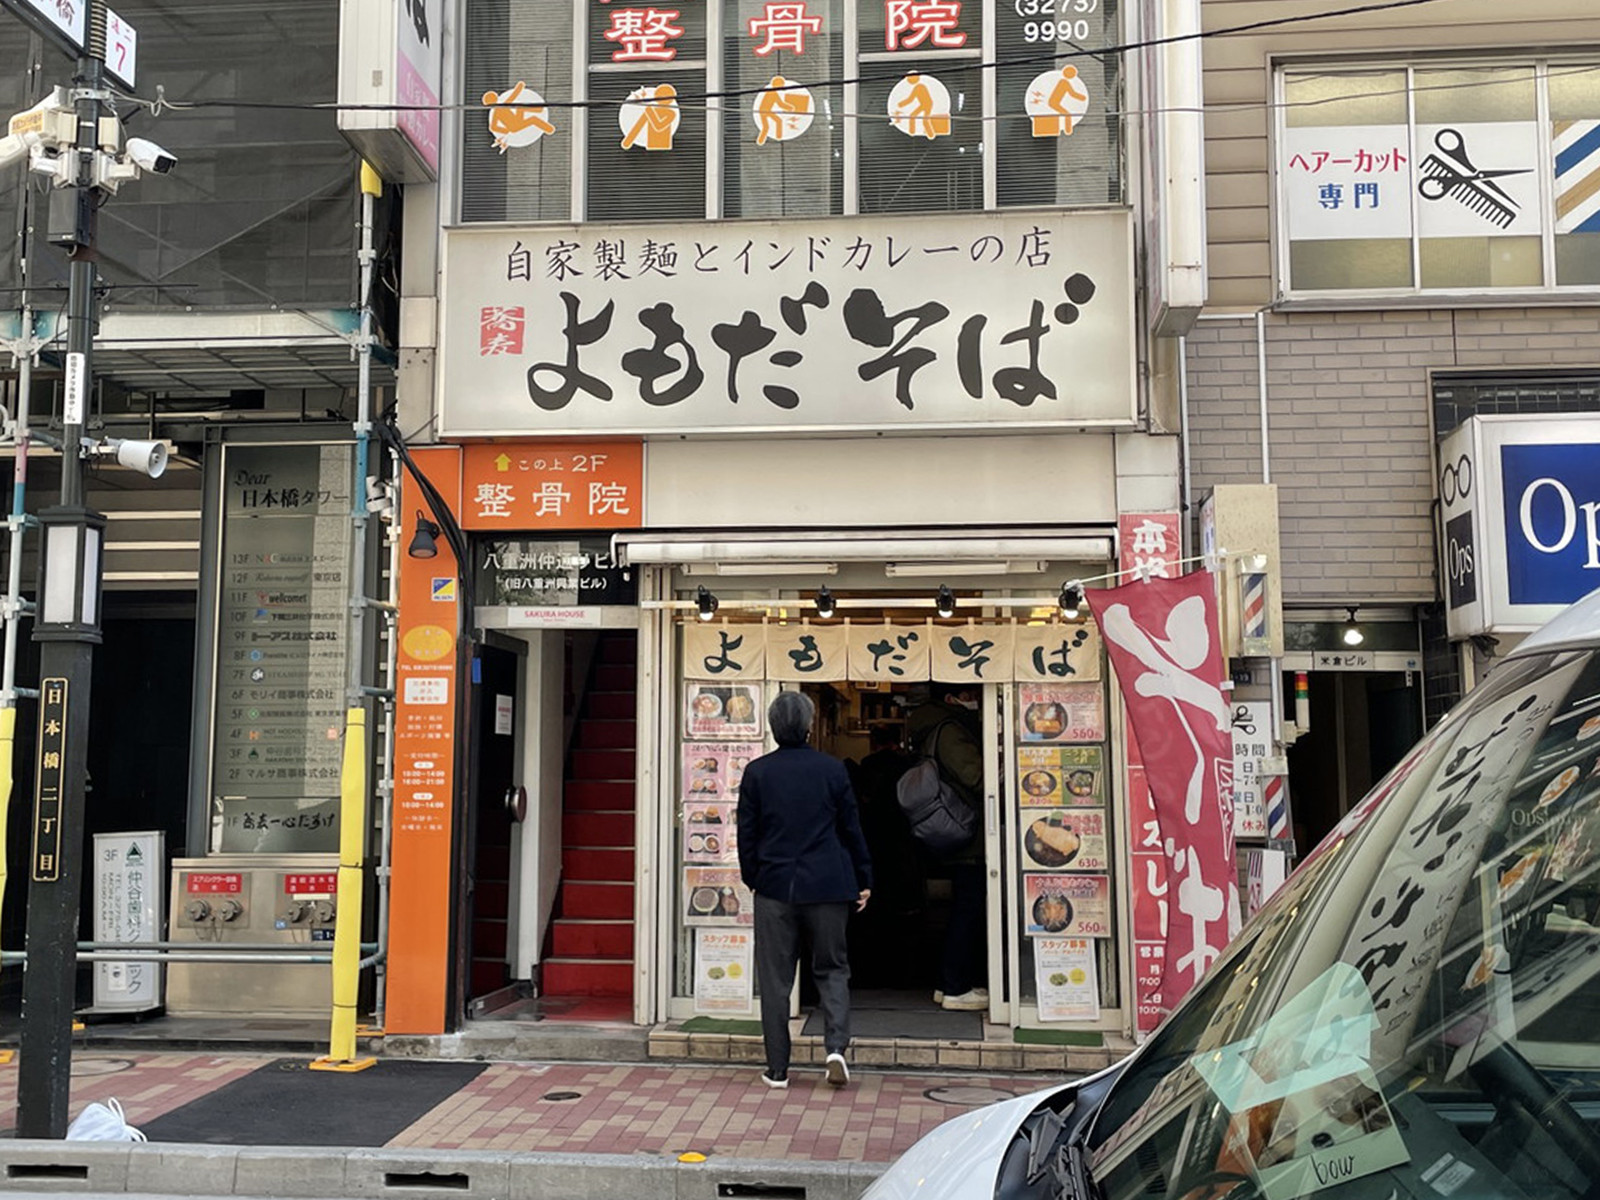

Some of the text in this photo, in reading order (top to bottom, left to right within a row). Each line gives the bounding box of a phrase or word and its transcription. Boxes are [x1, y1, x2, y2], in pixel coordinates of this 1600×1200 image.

[1024, 20, 1089, 42] 9990
[115, 42, 126, 72] 7
[1289, 148, 1408, 174] ヘアーカット
[1318, 182, 1380, 210] 専門
[505, 226, 1052, 282] 自家製麺とインドカレーの店
[527, 272, 1096, 410] よもだそば
[519, 454, 608, 473] この上 2F
[242, 488, 350, 508] 日本橋タワー
[474, 481, 630, 518] 整骨院
[1450, 537, 1474, 587] Ops
[704, 629, 1089, 678] よもだそば
[1320, 656, 1368, 667] 米倉ビル
[1235, 743, 1266, 757] 時間
[39, 688, 62, 871] 日本橋二丁目
[103, 850, 118, 862] 3F
[1310, 1154, 1357, 1186] bow
